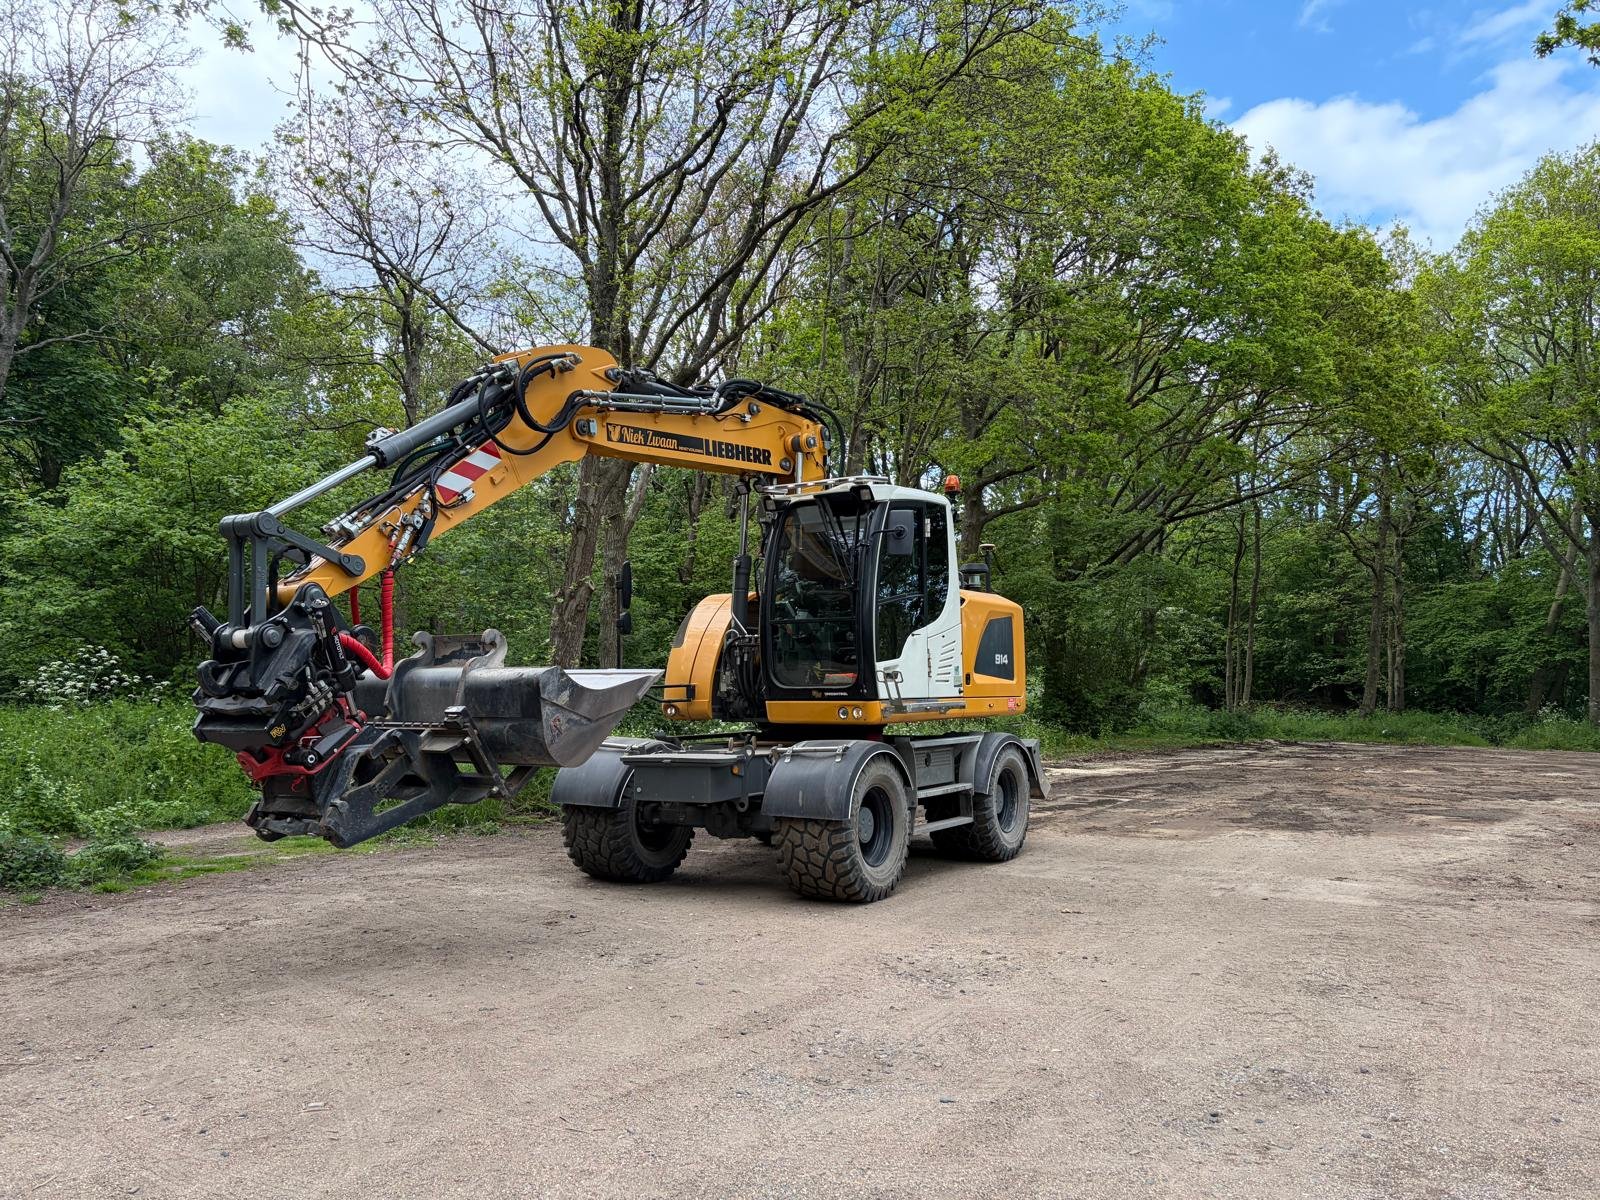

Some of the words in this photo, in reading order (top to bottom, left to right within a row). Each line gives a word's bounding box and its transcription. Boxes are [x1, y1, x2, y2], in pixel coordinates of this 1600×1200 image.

[622, 427, 644, 444] Niek
[646, 430, 678, 450] Zwaan
[705, 439, 772, 465] LIEBHERR
[995, 654, 1008, 664] 914
